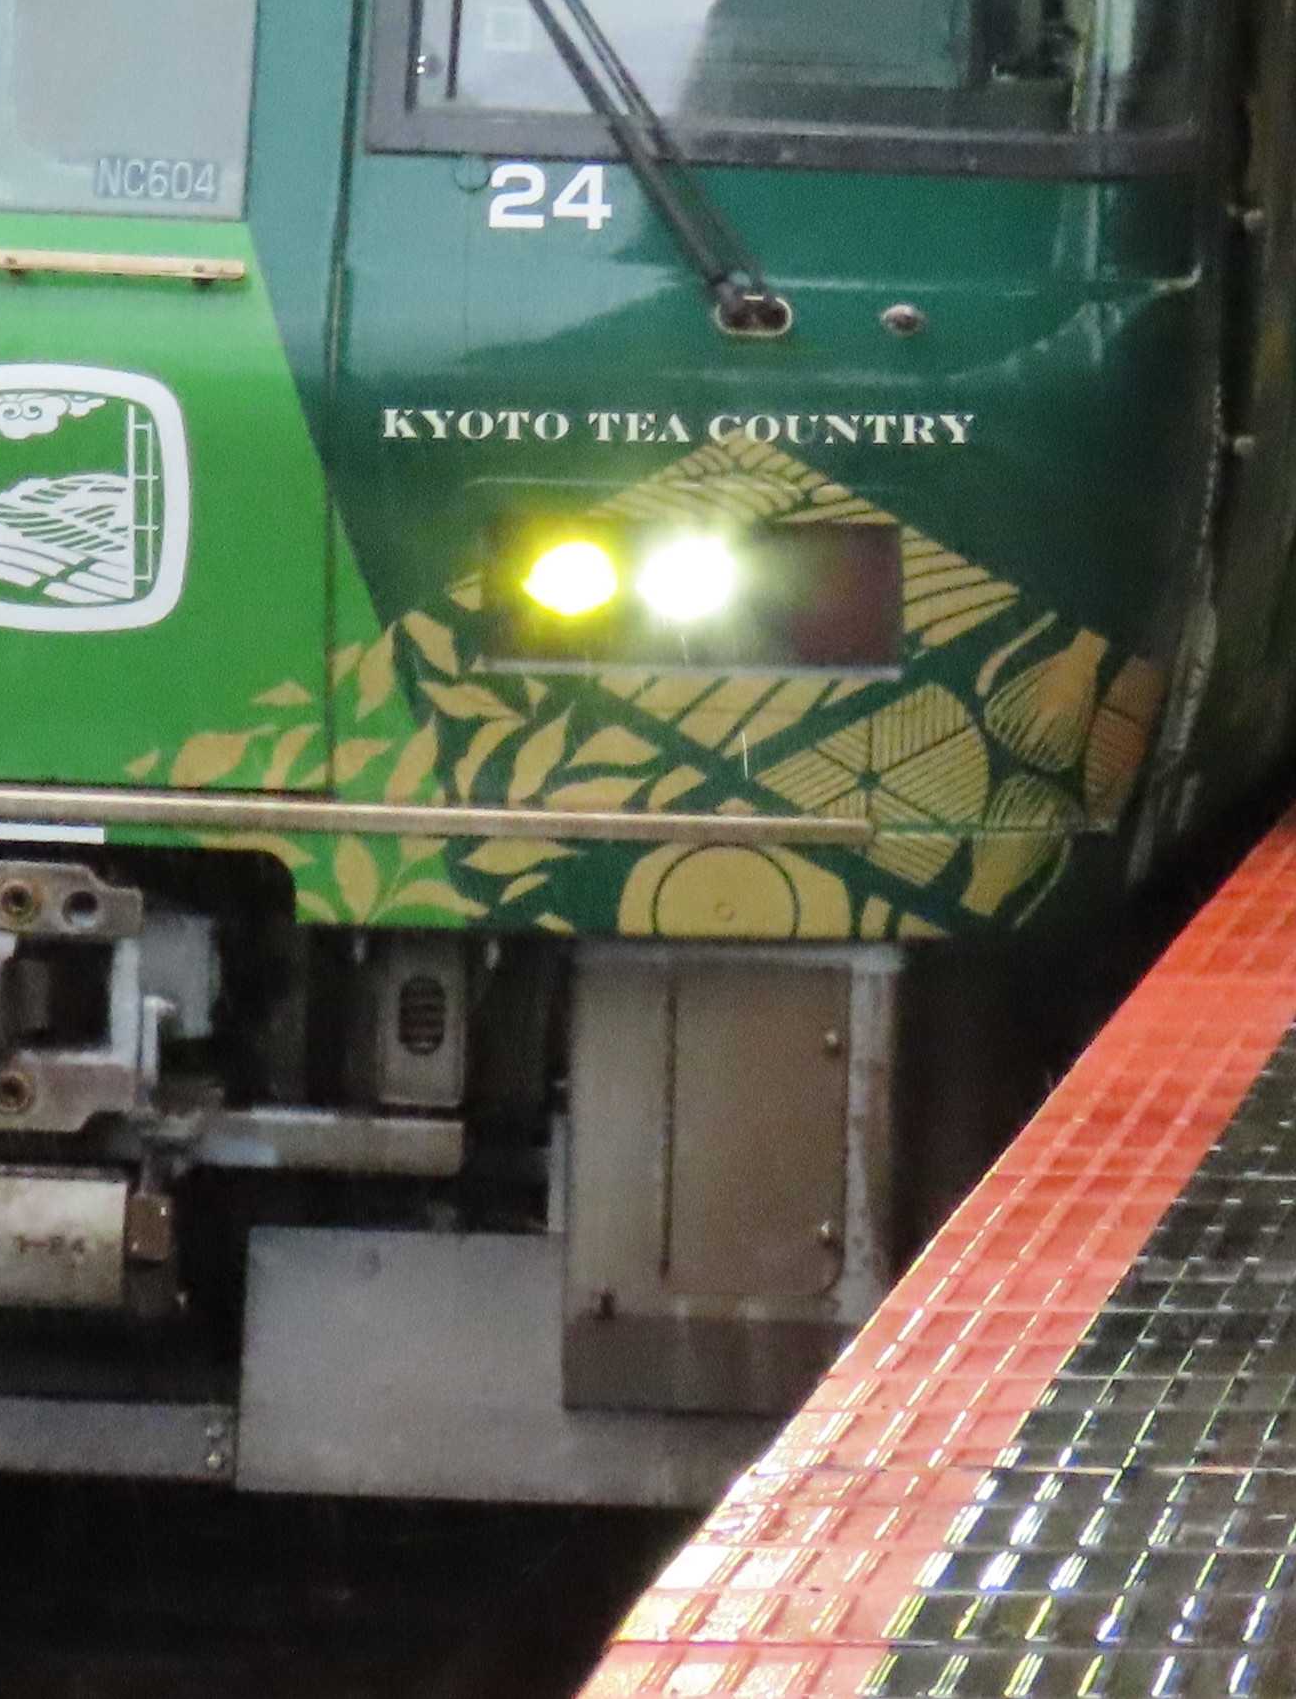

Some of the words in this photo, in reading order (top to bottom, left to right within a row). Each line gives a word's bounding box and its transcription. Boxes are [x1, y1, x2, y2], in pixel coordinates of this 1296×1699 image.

[96, 157, 217, 201] NC604
[488, 163, 613, 231] 24
[382, 408, 570, 440] KYOTO
[587, 412, 692, 443] TEA
[707, 414, 976, 446] COUNTRY
